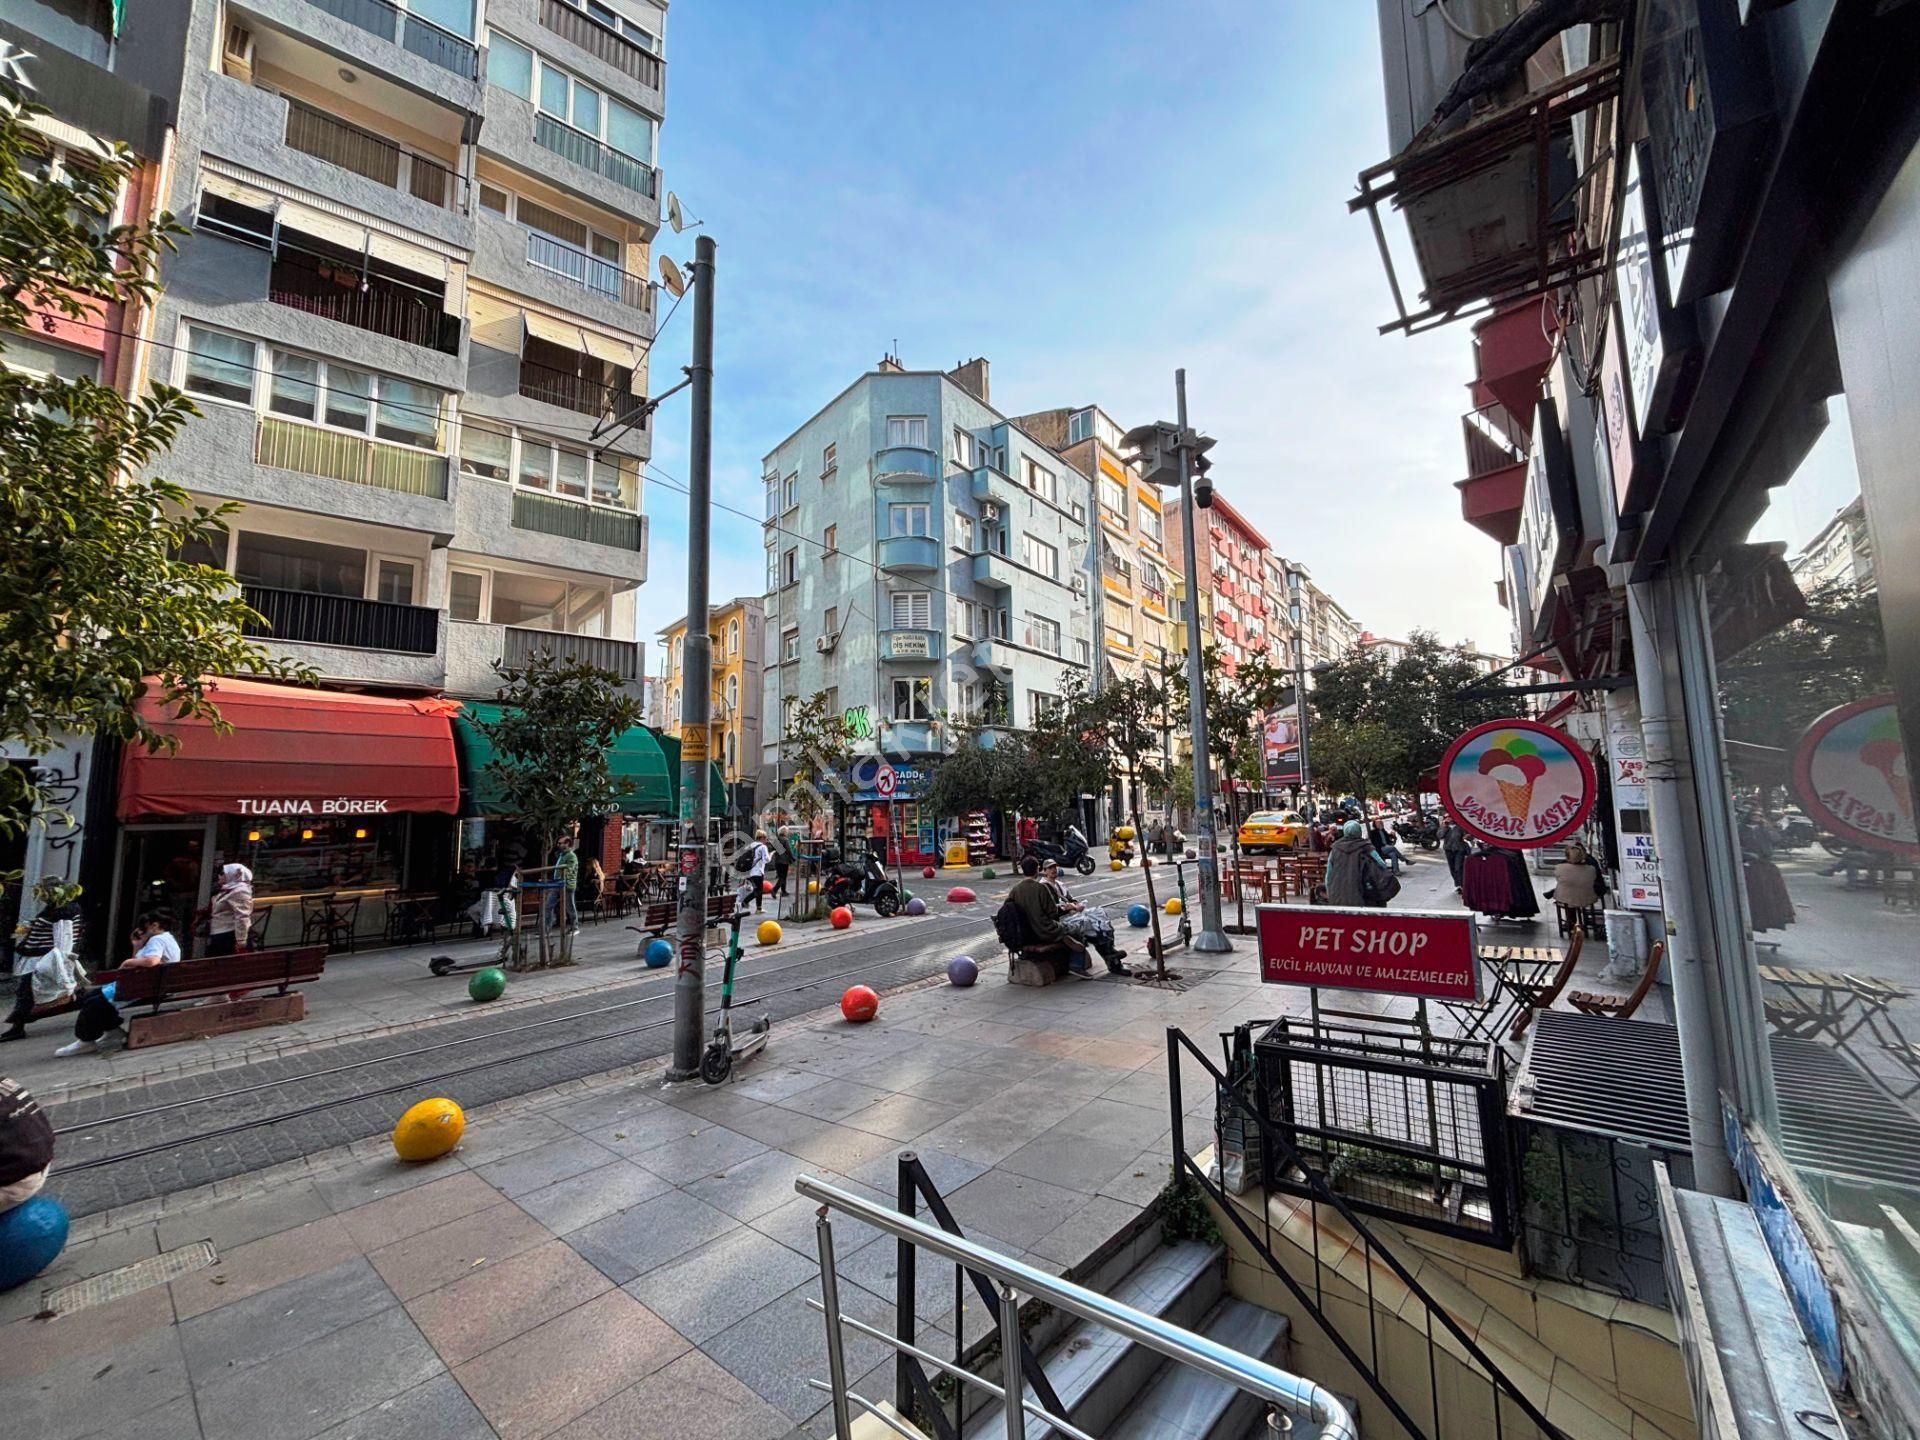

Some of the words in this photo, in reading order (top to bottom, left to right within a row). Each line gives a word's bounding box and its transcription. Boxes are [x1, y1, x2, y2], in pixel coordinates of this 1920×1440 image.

[237, 799, 313, 814] TUANA
[322, 797, 388, 814] BÖREK
[1533, 794, 1582, 832] USTA
[1298, 926, 1345, 951] PET
[1350, 928, 1428, 957] SHOP
[1270, 956, 1301, 972] EVCİL
[1305, 960, 1353, 977] HAYVAN
[1356, 966, 1372, 977] VE
[1375, 967, 1469, 986] MALZEMELERİ
